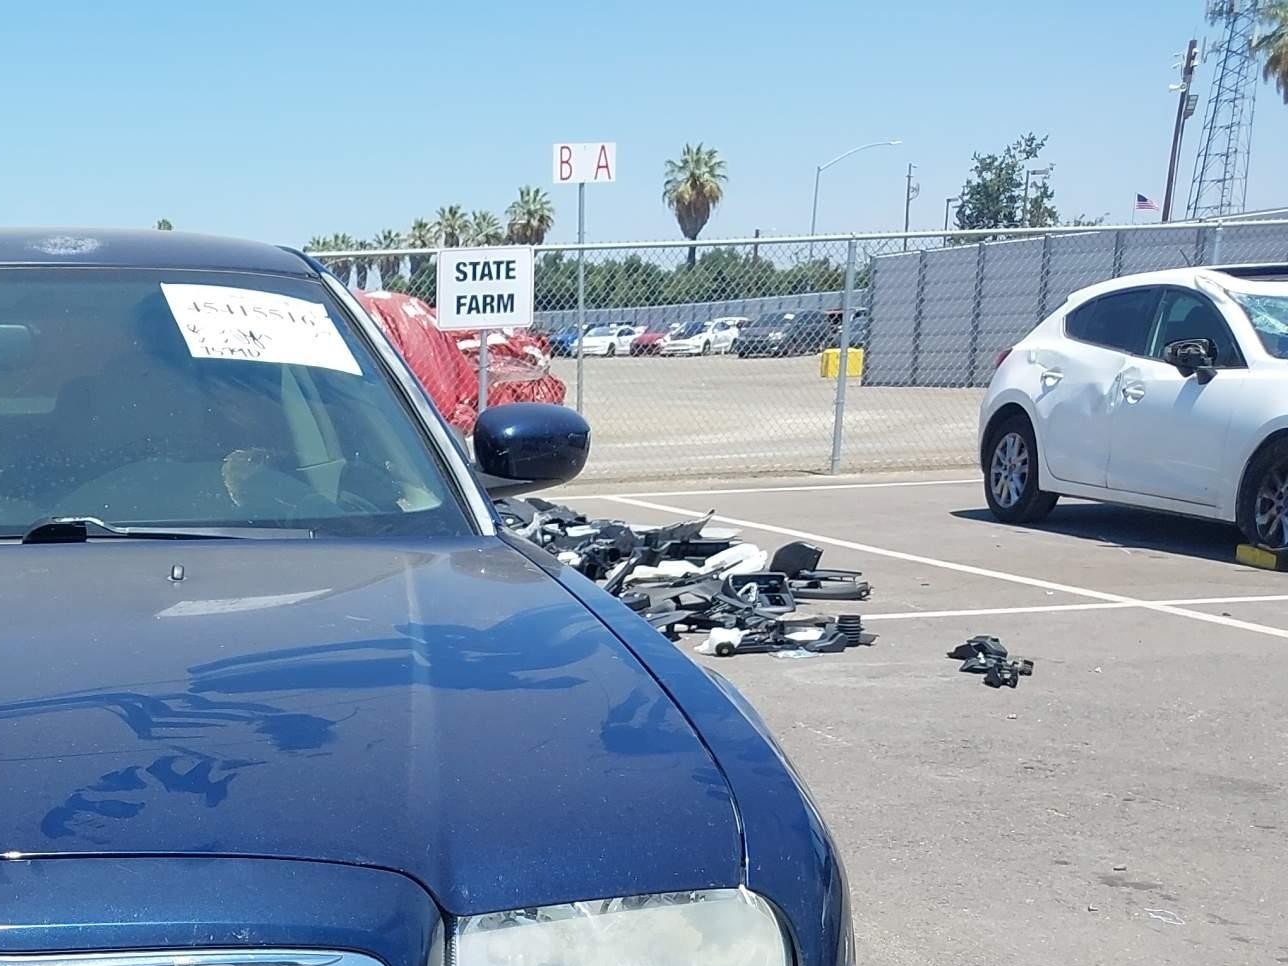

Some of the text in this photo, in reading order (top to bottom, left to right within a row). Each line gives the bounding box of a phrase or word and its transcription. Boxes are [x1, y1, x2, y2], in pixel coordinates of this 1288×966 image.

[559, 144, 612, 181] B A
[454, 259, 517, 283] STATE
[455, 292, 515, 316] FARM
